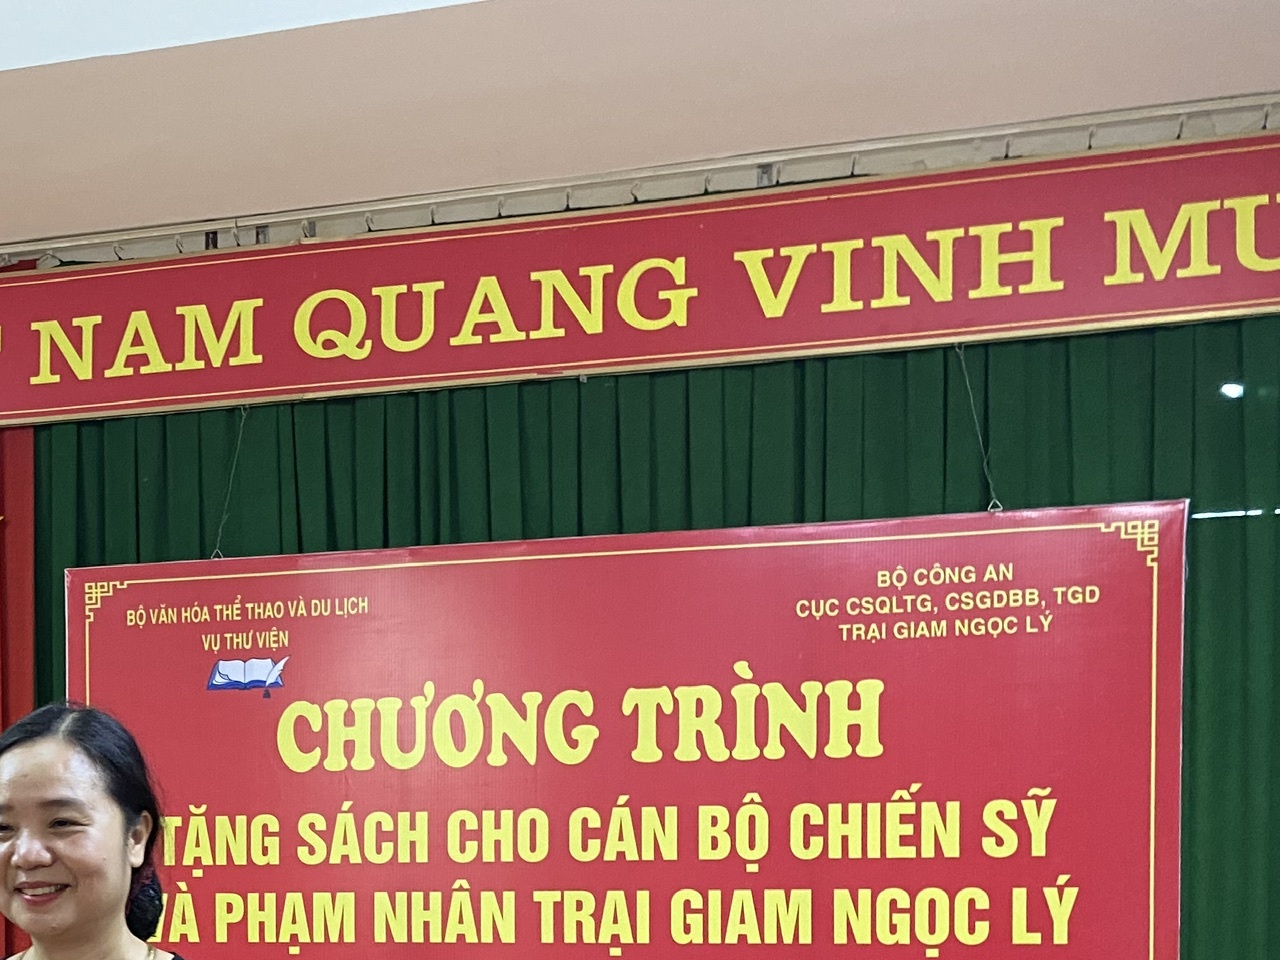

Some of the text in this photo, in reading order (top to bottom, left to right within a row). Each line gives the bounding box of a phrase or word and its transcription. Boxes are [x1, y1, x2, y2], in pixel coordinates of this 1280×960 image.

[30, 298, 263, 385] NAM
[293, 256, 698, 361] QUANG
[734, 217, 1064, 319] VINH
[877, 562, 1014, 591] BỘ CÔNG AN
[126, 595, 369, 628] BỘ VĂN HÓA THỂ THAO VÀ DU LỊCH
[796, 585, 1100, 621] CỤC CSQLTG, CSGDBB, TGD
[202, 626, 289, 654] VỤ THƯ VIỆN
[839, 609, 1054, 643] TRẠI GIAM NGỌC LÝ
[276, 660, 885, 774] CHƯƠNG TRÌNH
[160, 782, 1058, 878] TẶNG SÁCH CHO CÁN BỘ CHIẾN SỸ
[215, 891, 355, 955] PHẠM
[374, 879, 516, 944] NHÂN
[533, 889, 651, 957] TRẠI
[670, 888, 813, 946] GIAM
[833, 887, 991, 958] NGỌC
[1012, 874, 1080, 945] LÝ
